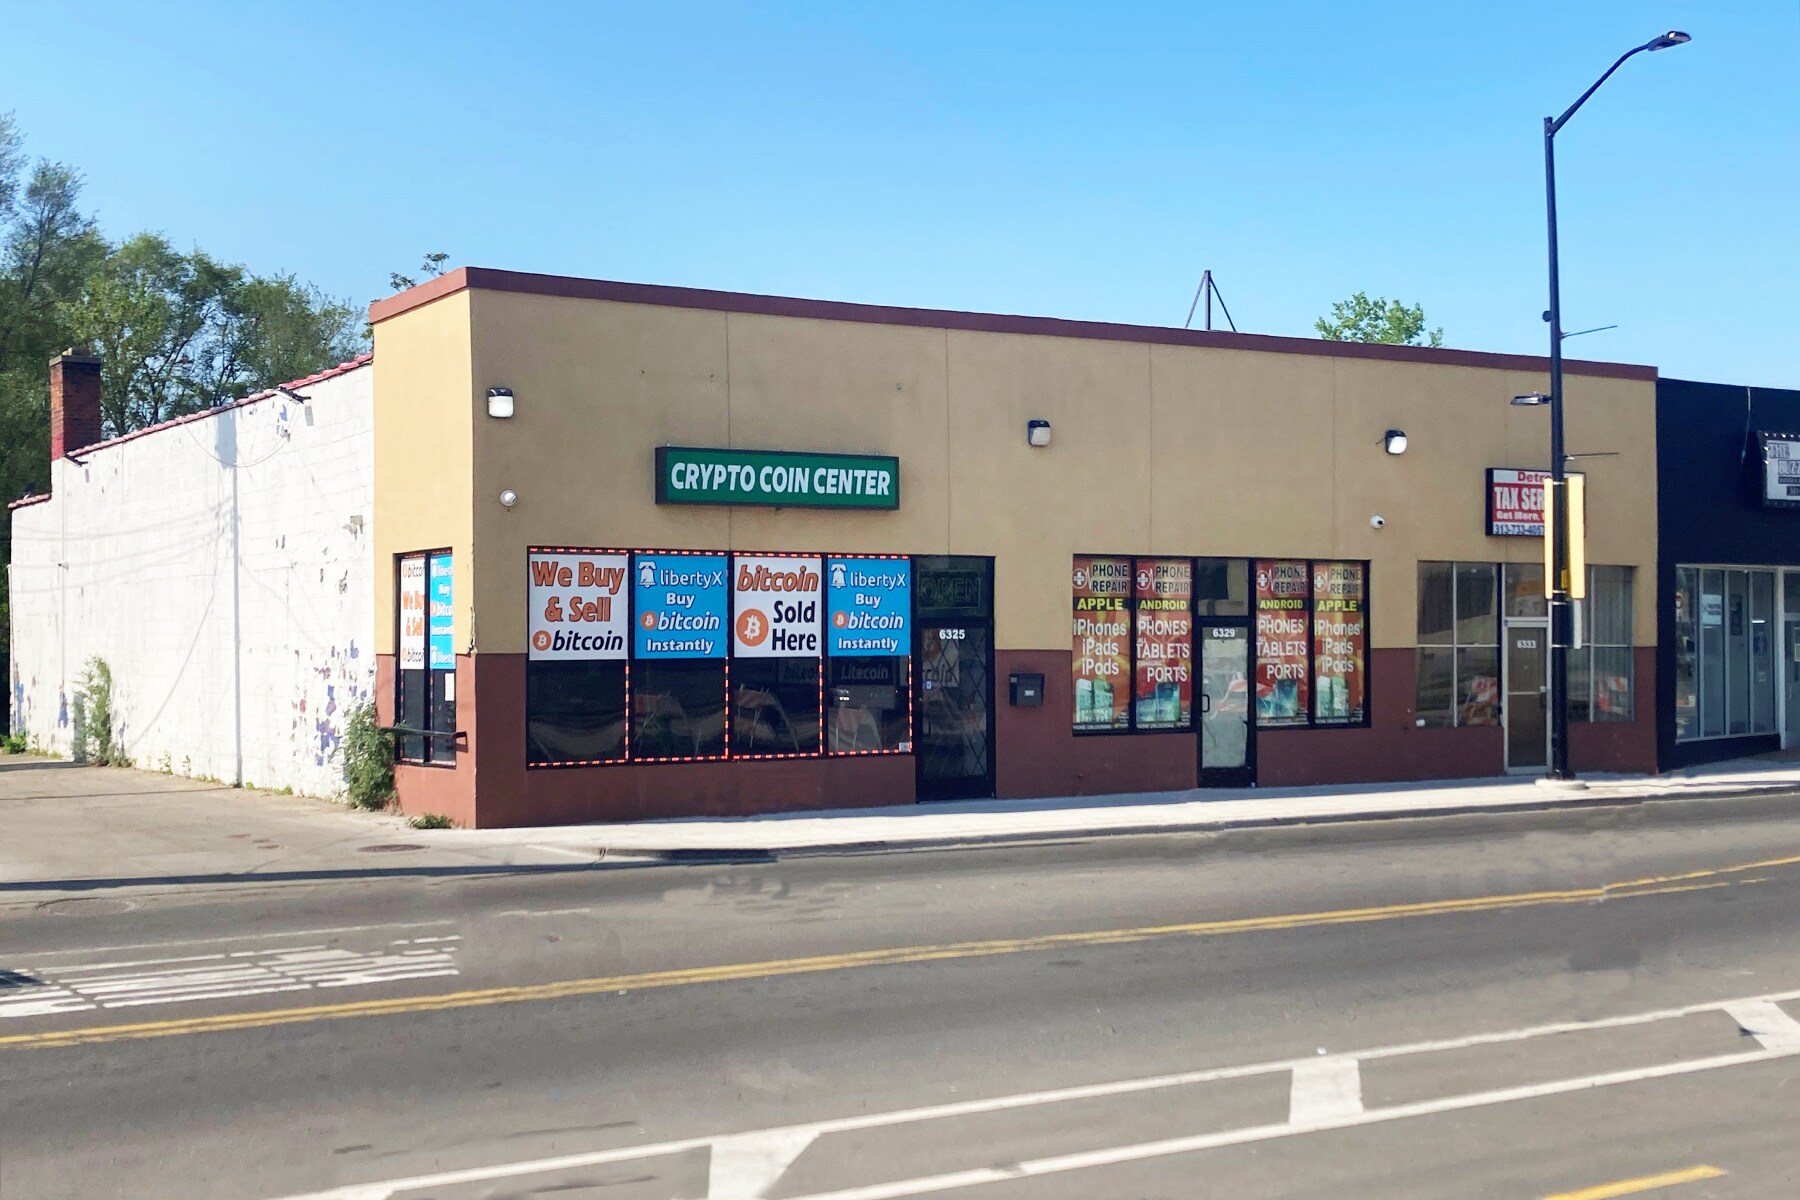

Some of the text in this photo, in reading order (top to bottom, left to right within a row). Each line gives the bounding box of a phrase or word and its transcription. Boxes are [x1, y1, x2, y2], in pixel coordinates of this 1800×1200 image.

[671, 462, 891, 495] CRYPTO COIN CENTER
[1494, 487, 1519, 510] TAX
[1496, 511, 1512, 520] Get
[532, 561, 625, 595] We Buy
[660, 569, 723, 588] libertyX
[737, 565, 819, 592] bitcoin
[1092, 564, 1128, 577] PHONE
[1155, 565, 1190, 578] PHONE
[1274, 568, 1305, 578] PHONE
[1330, 569, 1361, 580] PHONE
[850, 573, 907, 590] libertyX
[921, 577, 980, 601] OPEN
[1092, 580, 1128, 593] REPAIR
[1155, 581, 1190, 593] REPAIR
[1274, 582, 1306, 593] REPAIR
[438, 583, 450, 598] Buy
[403, 591, 413, 609] We
[666, 592, 695, 608] Buy
[855, 593, 881, 608] Buy
[1077, 598, 1124, 611] APPLE
[1140, 600, 1187, 610] ANDROID
[1260, 600, 1303, 609] ANDROID
[1317, 600, 1357, 611] APPLE
[544, 596, 611, 622] & Sell
[773, 601, 816, 623] Sold
[412, 617, 423, 636] Sell
[657, 611, 720, 631] bitcoin
[848, 611, 903, 629] bitcoin
[1073, 619, 1127, 636] iPhones
[1138, 620, 1188, 636] PHONES
[1258, 619, 1304, 634] PHONES
[1315, 619, 1360, 635] iPhones
[552, 630, 623, 651] bitcoin
[772, 629, 817, 651] Here
[939, 629, 965, 640] 6325
[1212, 628, 1235, 637] 6329
[647, 638, 714, 655] Instantly
[838, 638, 898, 652] Instantly
[1082, 638, 1119, 656] iPads
[1136, 643, 1190, 658] TABLETS
[1256, 641, 1307, 656] TABLETS
[1322, 637, 1353, 654] iPads
[841, 663, 889, 681] Litecoin
[1082, 658, 1119, 675] iPods
[1266, 664, 1304, 679] PORTS
[1321, 656, 1354, 672] iPods
[1147, 667, 1187, 682] PORTS
